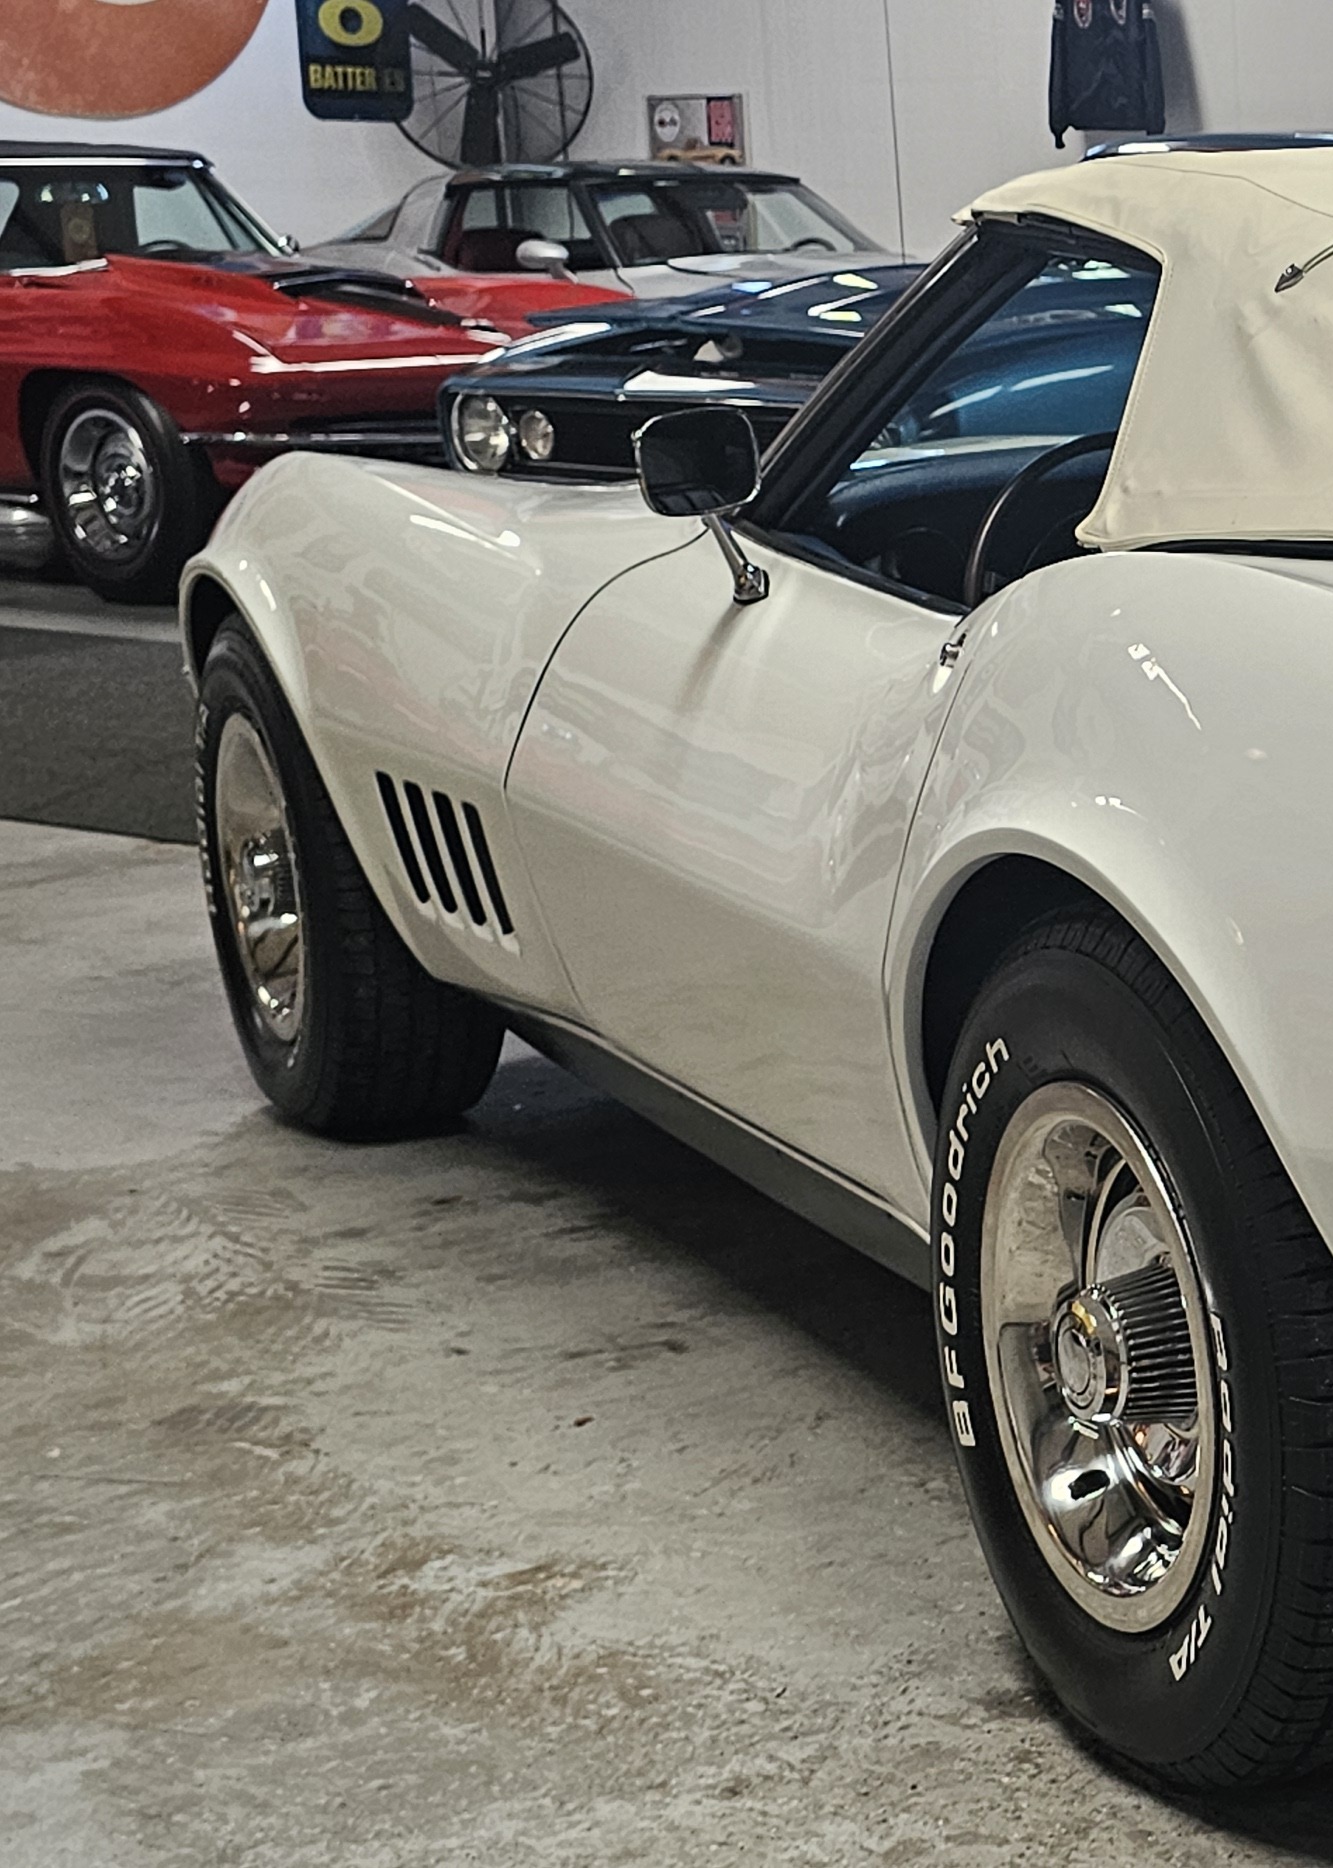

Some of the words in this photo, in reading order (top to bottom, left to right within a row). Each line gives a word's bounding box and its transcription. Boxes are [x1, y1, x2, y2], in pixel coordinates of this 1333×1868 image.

[309, 63, 405, 92] BATTERES
[939, 1036, 1010, 1448] BFGoodrich
[1169, 1604, 1213, 1682] T/A
